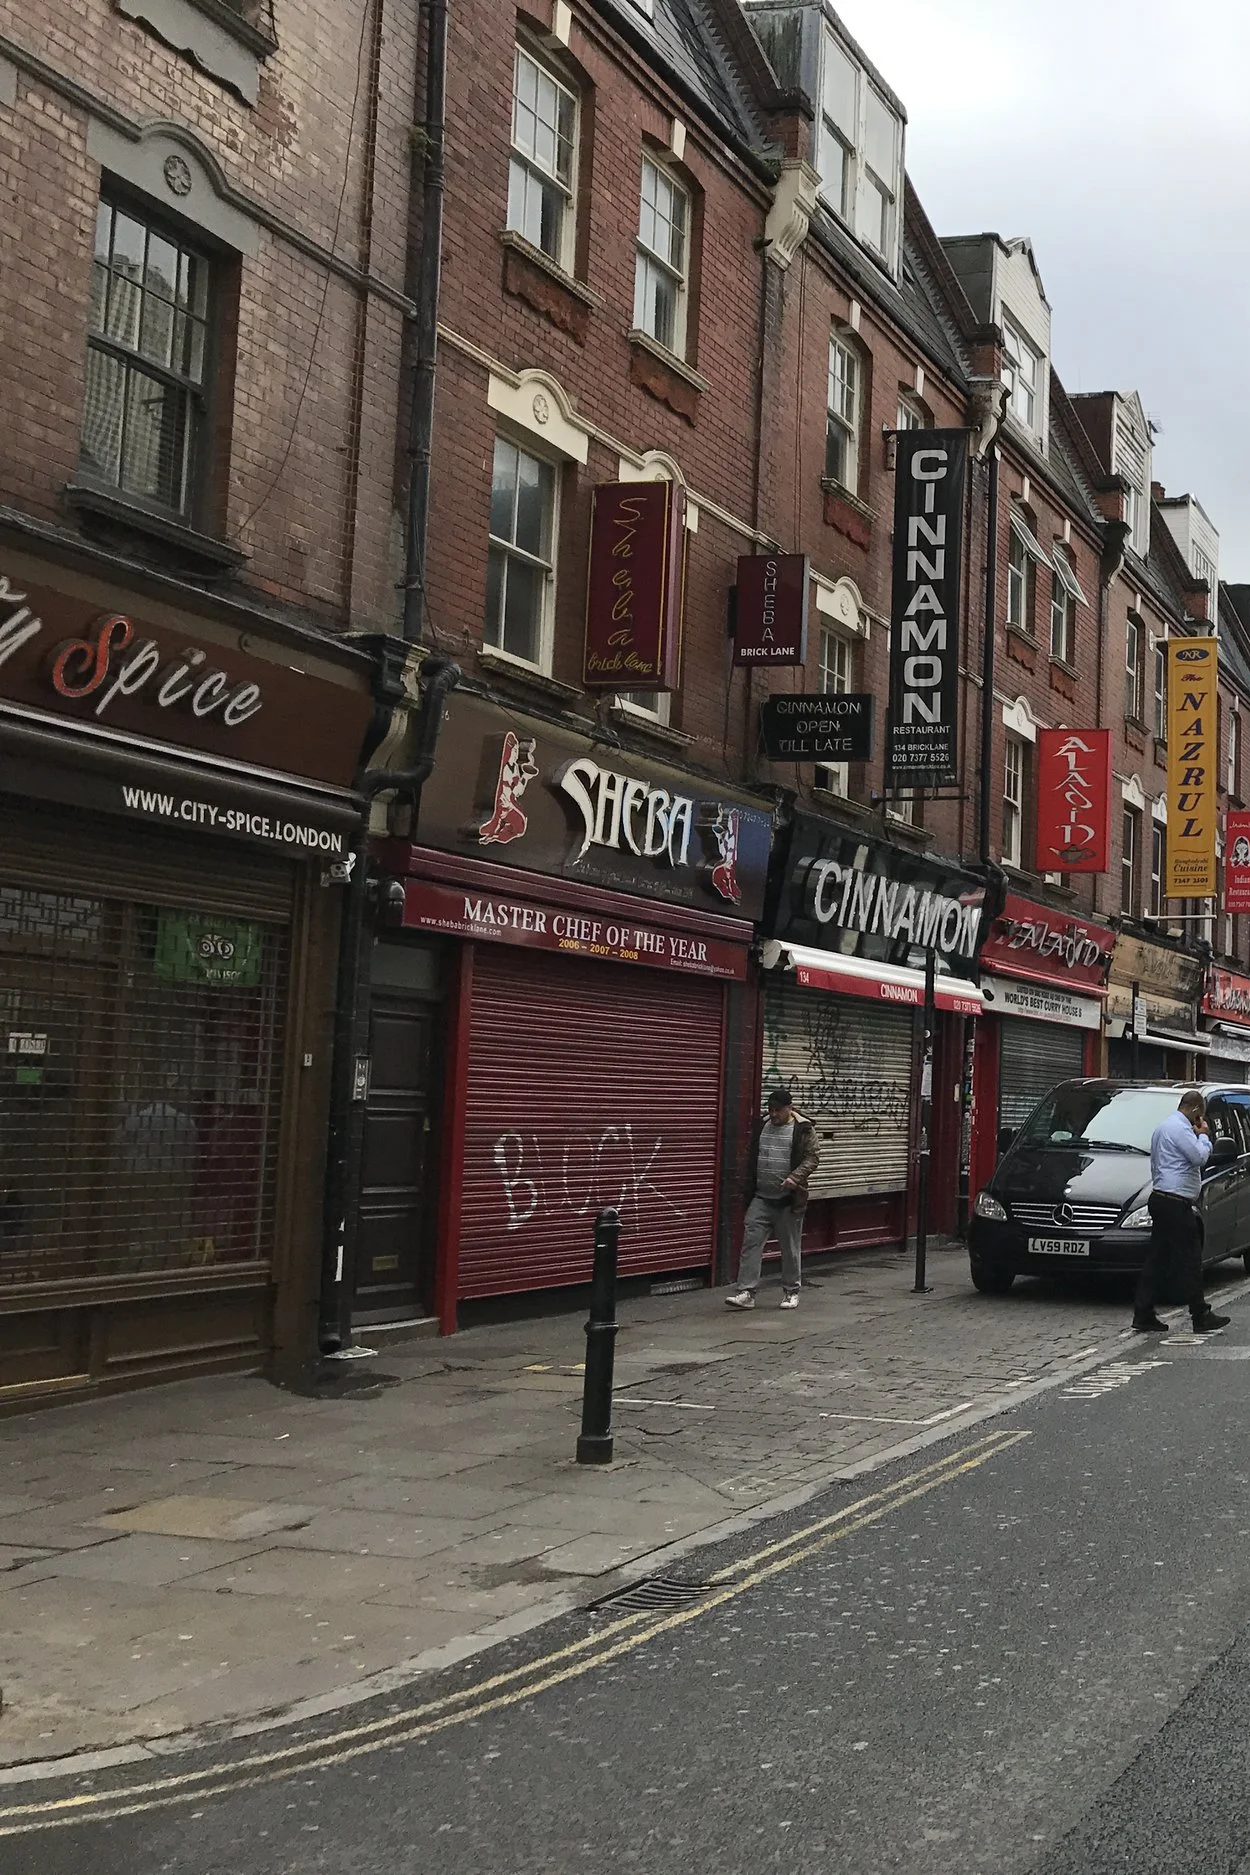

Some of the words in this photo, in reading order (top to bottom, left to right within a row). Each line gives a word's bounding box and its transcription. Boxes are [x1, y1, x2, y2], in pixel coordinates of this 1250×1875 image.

[901, 449, 948, 724] CINNAMON
[762, 561, 777, 641] SHEBA
[740, 648, 768, 656] BRICK
[770, 647, 795, 656] LANE
[1182, 648, 1203, 660] NR
[53, 615, 262, 726] Spice
[776, 701, 860, 714] CINNAMON
[797, 720, 840, 733] OPEN
[893, 726, 950, 734] RESTAURANT
[779, 738, 808, 752] TILL
[815, 737, 853, 751] LATE
[892, 753, 907, 762] 020
[910, 753, 928, 762] 7377
[1176, 692, 1208, 838] NAZRUL
[123, 785, 342, 852] WWW.CITY-SPICE.LONDON
[561, 757, 693, 869] SHEBA
[1173, 864, 1208, 873] Cuisine
[814, 860, 982, 959] CINNAMON
[463, 897, 547, 934] MASTER
[552, 915, 602, 942] CHEF
[606, 926, 631, 947] OF
[634, 930, 665, 954] THE
[669, 937, 707, 962] YEAR
[559, 938, 580, 950] 2006
[589, 943, 610, 955] 2007
[619, 949, 639, 960] 2008
[799, 971, 810, 984] 134
[880, 983, 918, 1002] CINNAMON
[1004, 991, 1029, 1006] WORLD'S
[1029, 996, 1043, 1010] BEST
[1044, 1000, 1061, 1013] CURRY
[1032, 1239, 1060, 1252] LV59
[1063, 1242, 1085, 1253] RDZ
